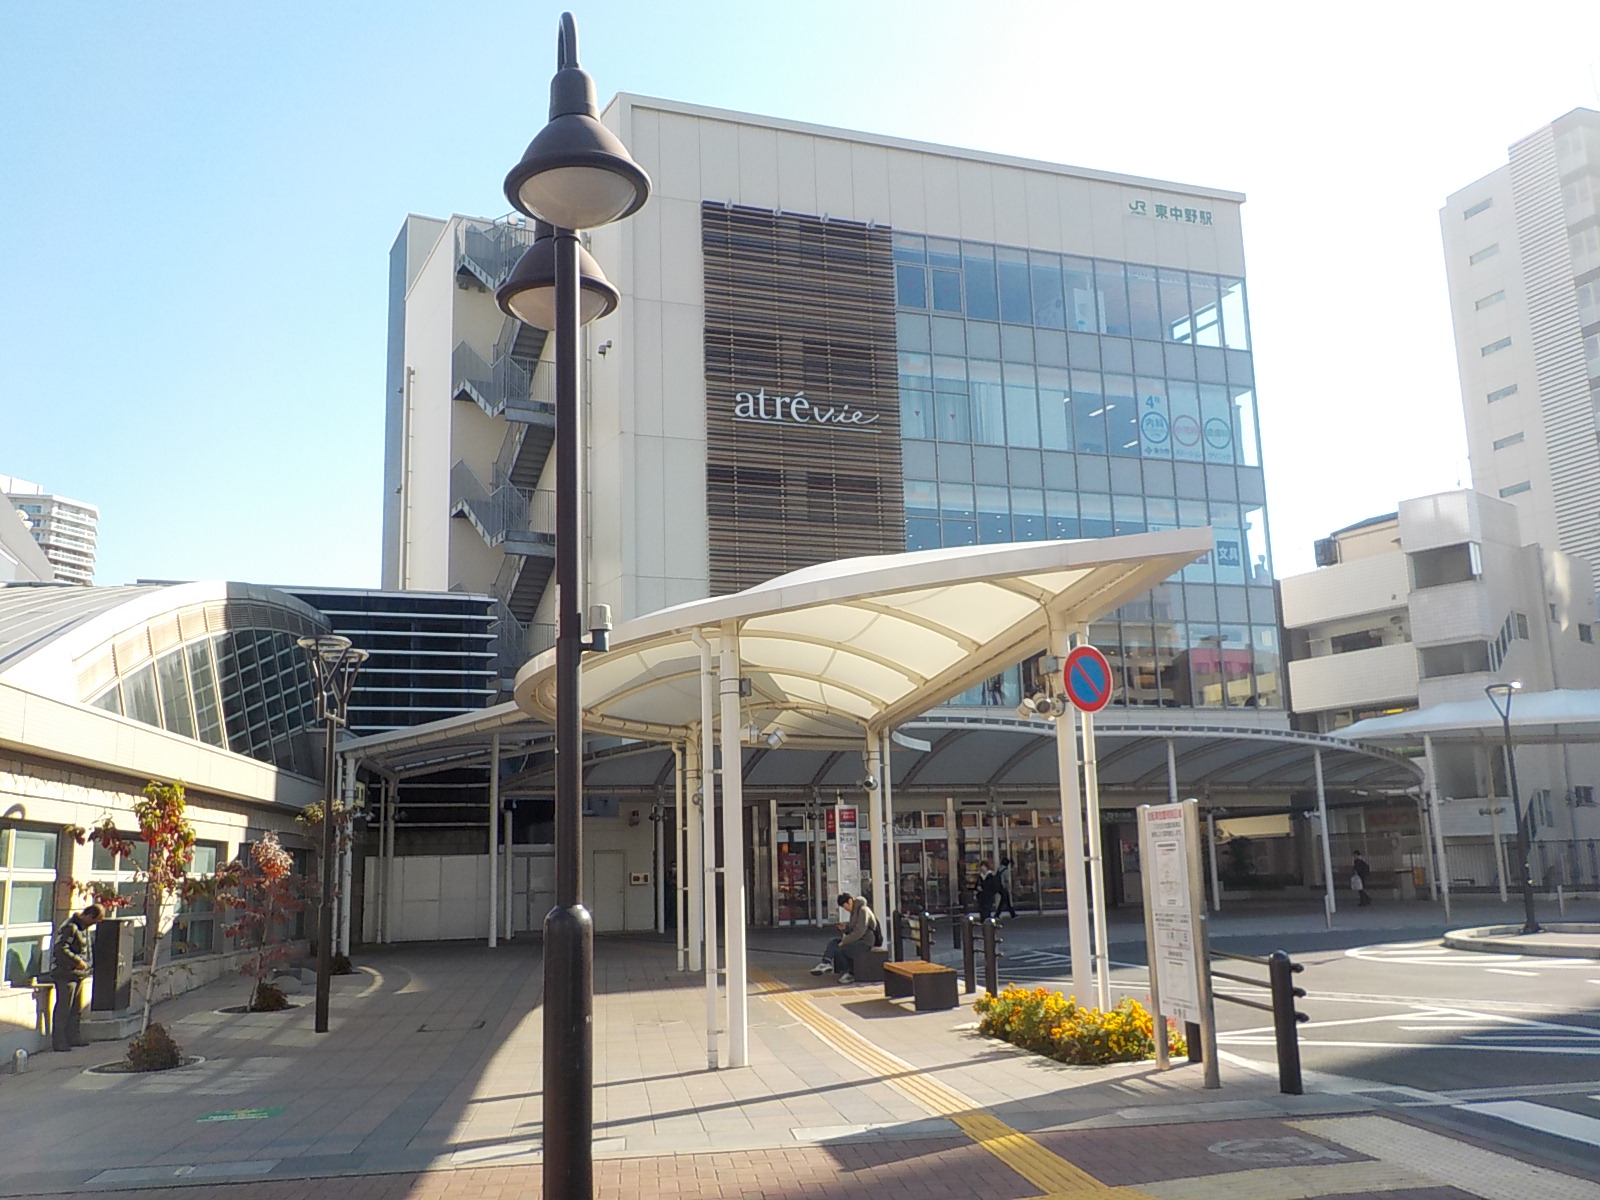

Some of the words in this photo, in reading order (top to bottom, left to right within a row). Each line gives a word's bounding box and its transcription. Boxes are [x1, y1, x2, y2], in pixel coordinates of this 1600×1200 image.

[1129, 200, 1147, 212] JR
[1154, 203, 1213, 226] 東中野駅
[1218, 546, 1239, 560] 文具
